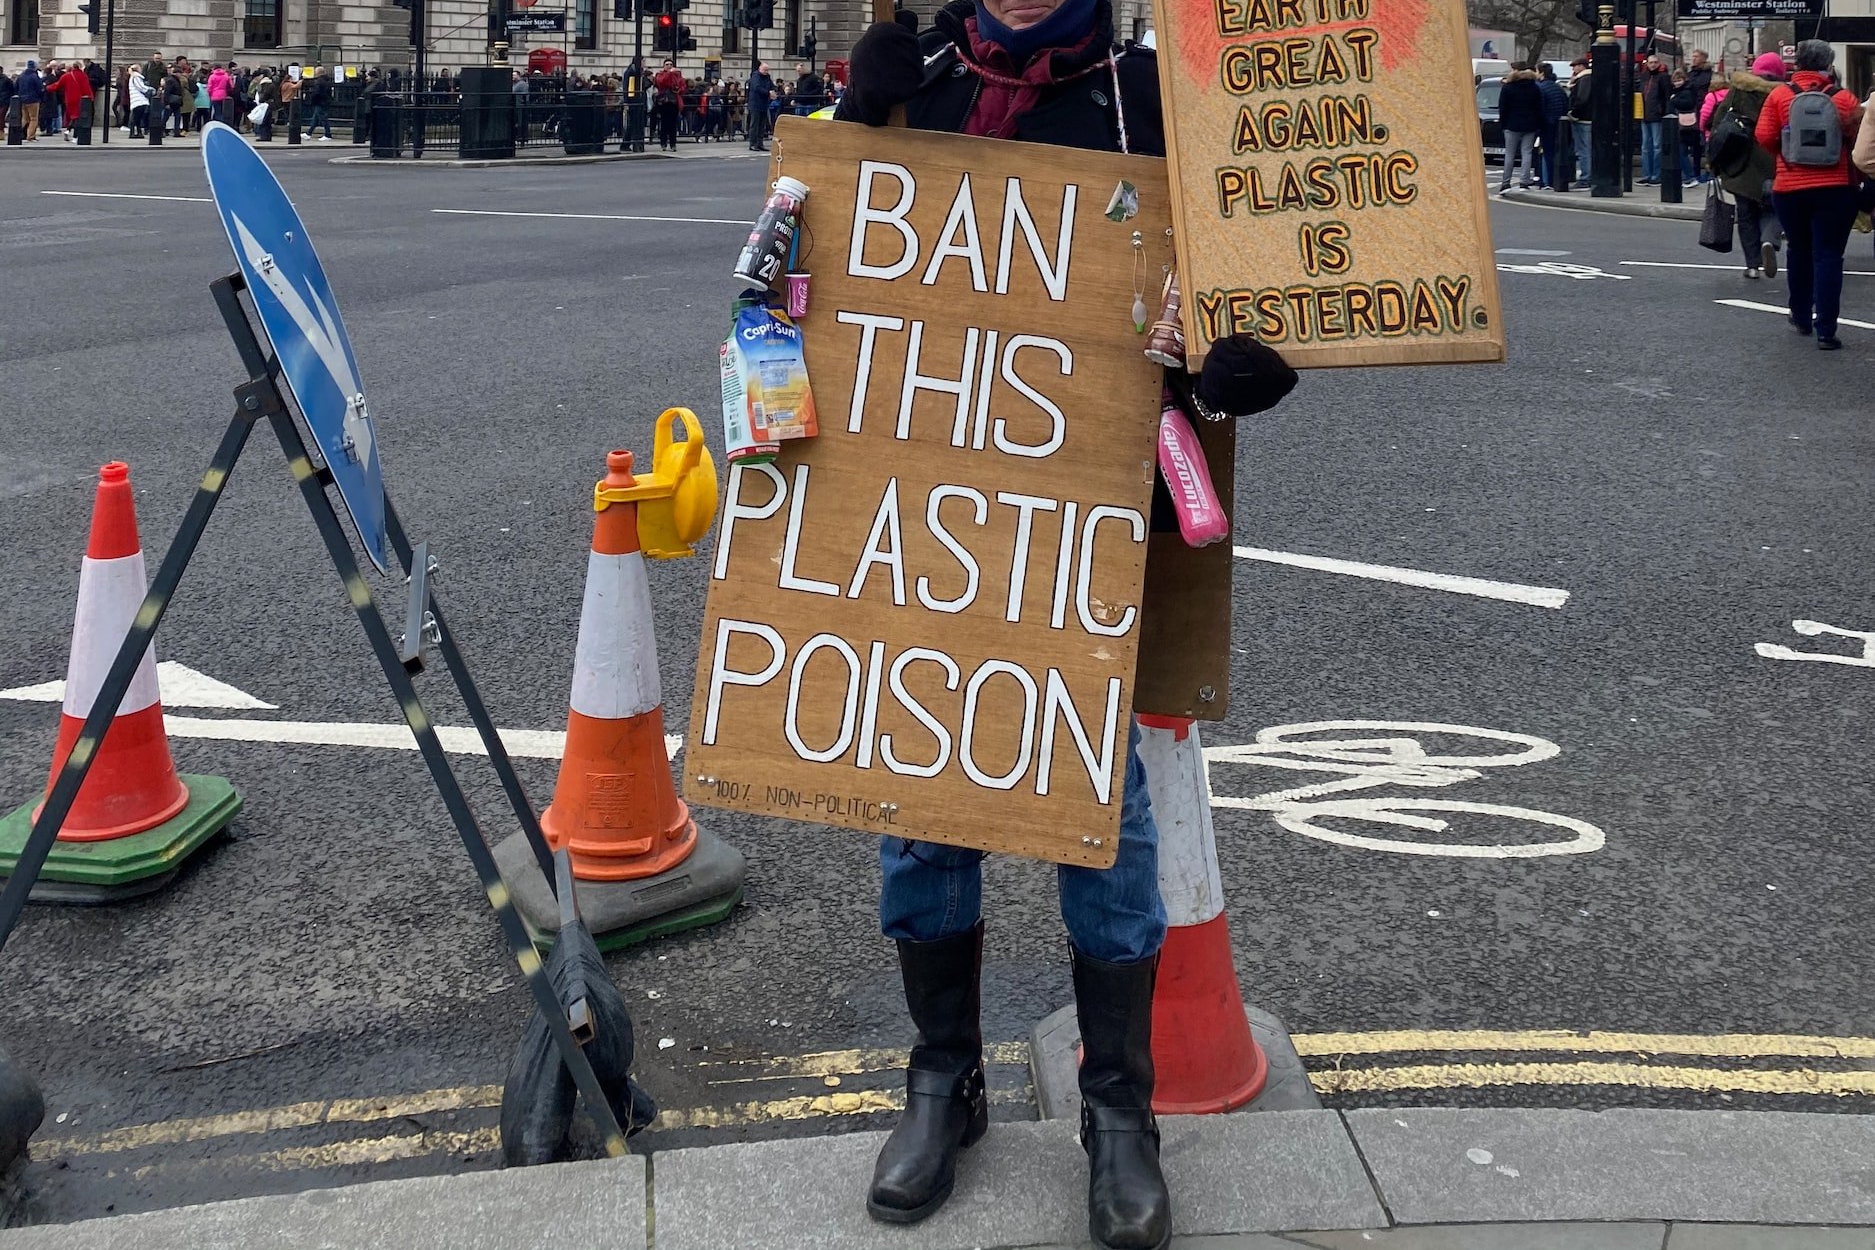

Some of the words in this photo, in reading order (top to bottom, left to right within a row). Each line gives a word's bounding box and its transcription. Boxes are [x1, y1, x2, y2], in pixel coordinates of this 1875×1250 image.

[1695, 0, 1763, 8] Westminster
[1765, 0, 1806, 8] Station
[1222, 28, 1378, 95] GREAT
[1233, 94, 1389, 155] AGAIN.
[1216, 150, 1419, 217] PLASTIC
[846, 159, 1078, 302] BAN
[1300, 221, 1351, 276] IS
[758, 254, 781, 281] 20
[1197, 275, 1489, 344] YESTERDAY.
[836, 310, 1075, 458] THIS
[1163, 429, 1201, 510] Lucozade
[713, 462, 1147, 638] PLASTIC
[700, 618, 1123, 805] POISON
[715, 779, 752, 802] 100%
[766, 785, 898, 825] NON-POLITICAL
